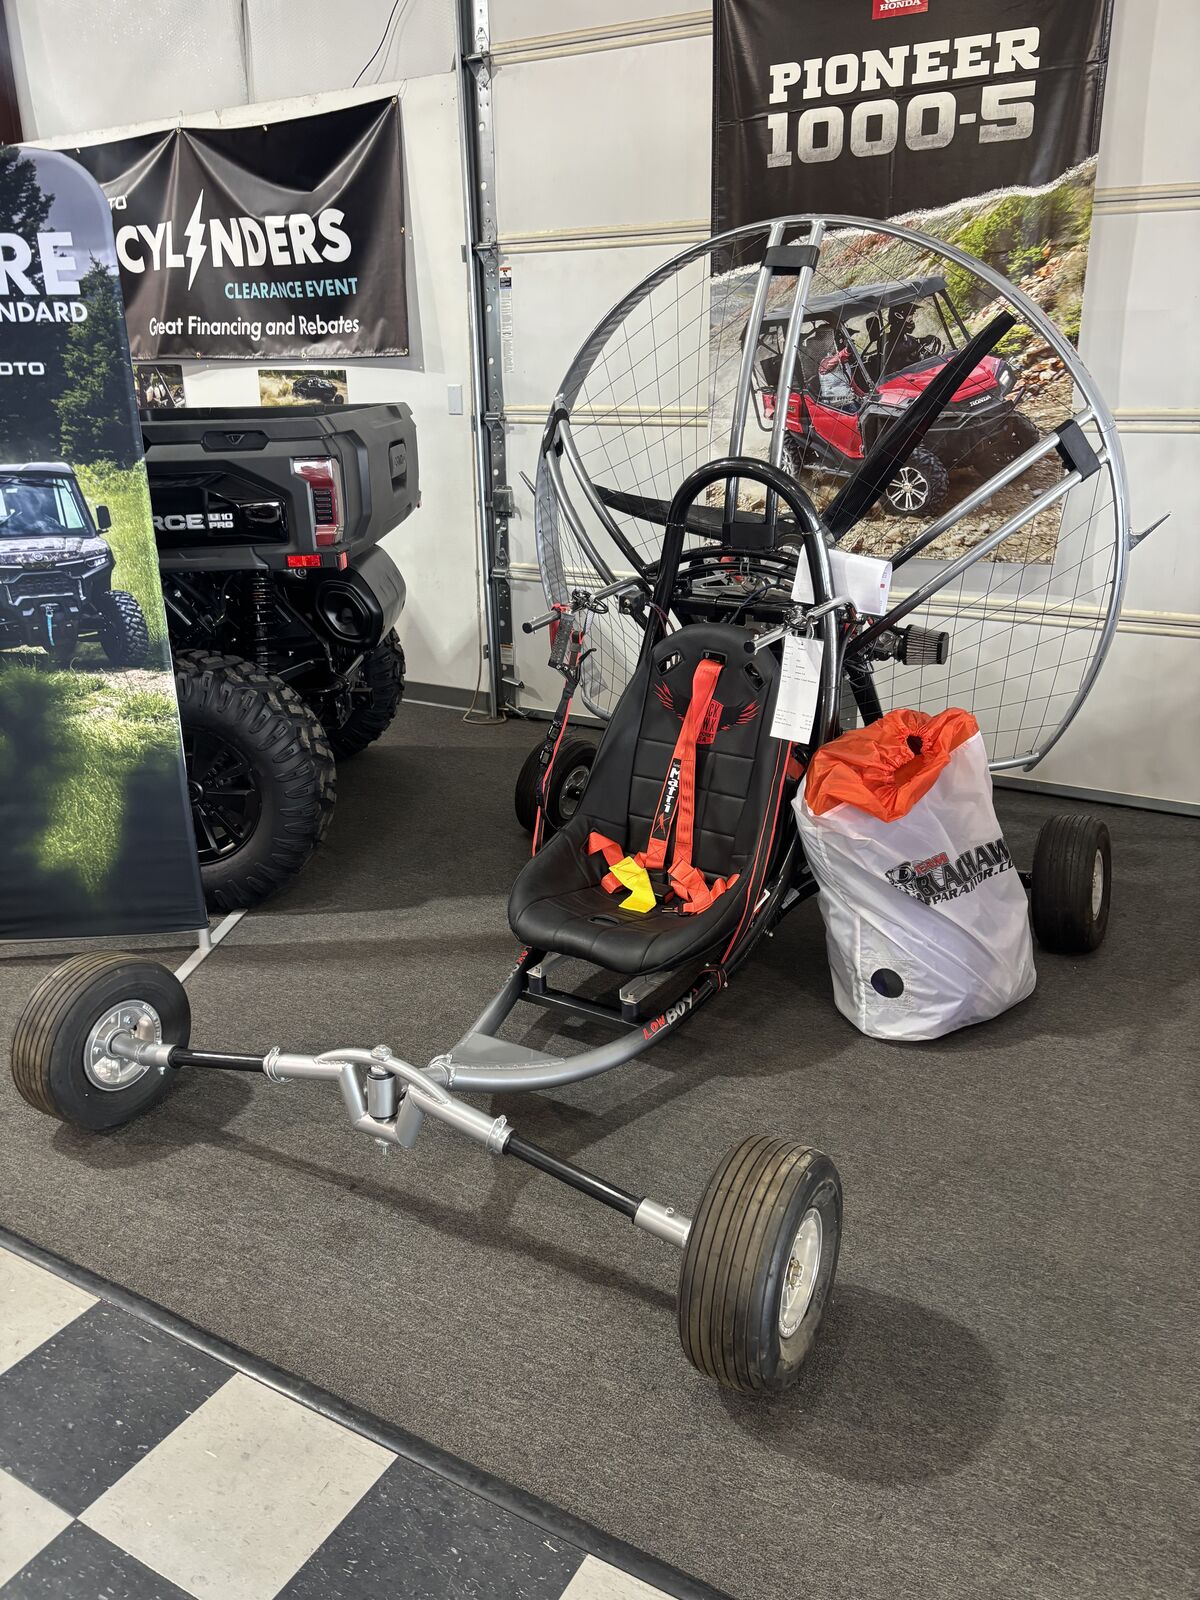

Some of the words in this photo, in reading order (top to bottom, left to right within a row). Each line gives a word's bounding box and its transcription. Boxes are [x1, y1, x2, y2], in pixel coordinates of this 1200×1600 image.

[880, 0, 921, 11] HONDA
[769, 27, 1040, 104] PIONEER
[767, 81, 1036, 168] 1000-5
[0, 232, 81, 295] RE
[224, 281, 303, 299] CLEARANCE
[305, 277, 358, 298] EVENT
[0, 302, 88, 323] NDARD
[149, 317, 183, 336] Great
[188, 315, 262, 341] Financing
[265, 315, 295, 335] and
[299, 314, 360, 334] Rebates
[0, 362, 45, 375] OTO
[208, 521, 234, 529] PRO
[914, 852, 949, 874] TEAM
